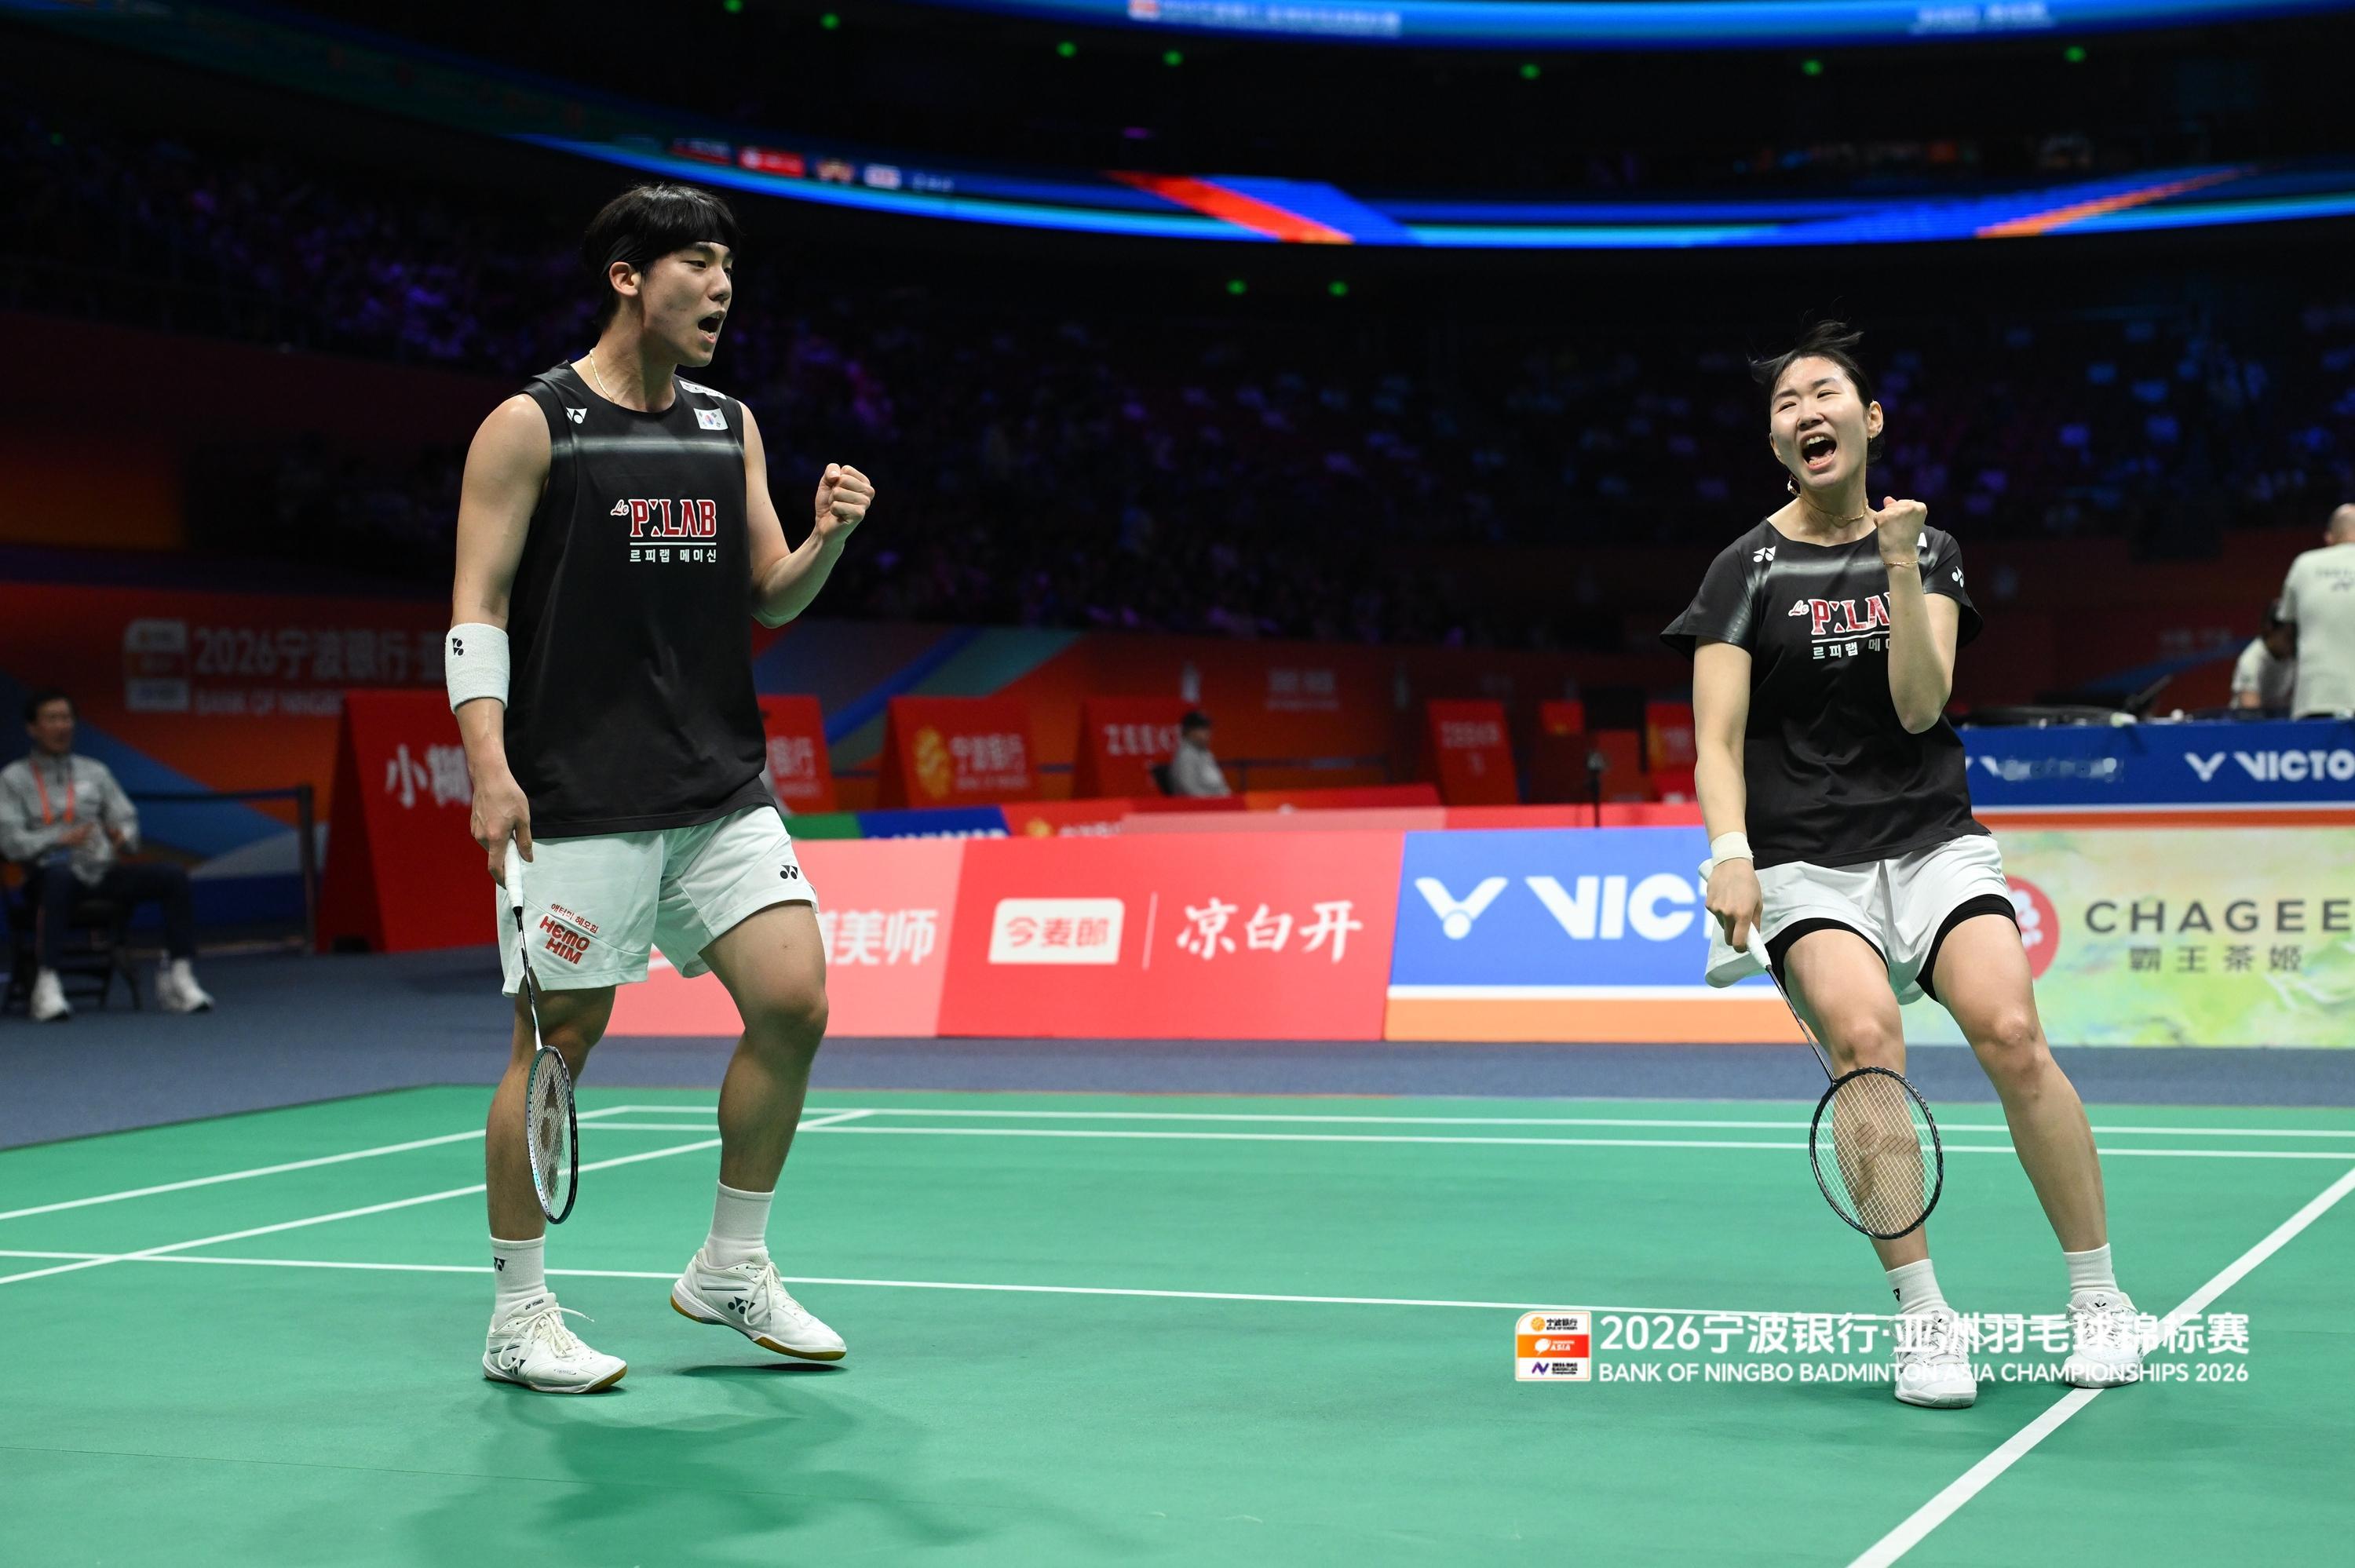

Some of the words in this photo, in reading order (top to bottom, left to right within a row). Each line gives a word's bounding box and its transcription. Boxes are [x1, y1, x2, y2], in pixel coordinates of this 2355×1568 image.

[630, 549, 670, 563] 르피랩
[680, 549, 717, 563] 메이신
[1813, 641, 1858, 659] 르피랩
[2233, 749, 2355, 782] VICTO
[540, 915, 590, 951] HEMO
[1006, 916, 1109, 947] 今麦郎
[1177, 897, 1364, 963] 凉白开
[2086, 900, 2352, 933] CHAGEE
[546, 938, 583, 965] HIM
